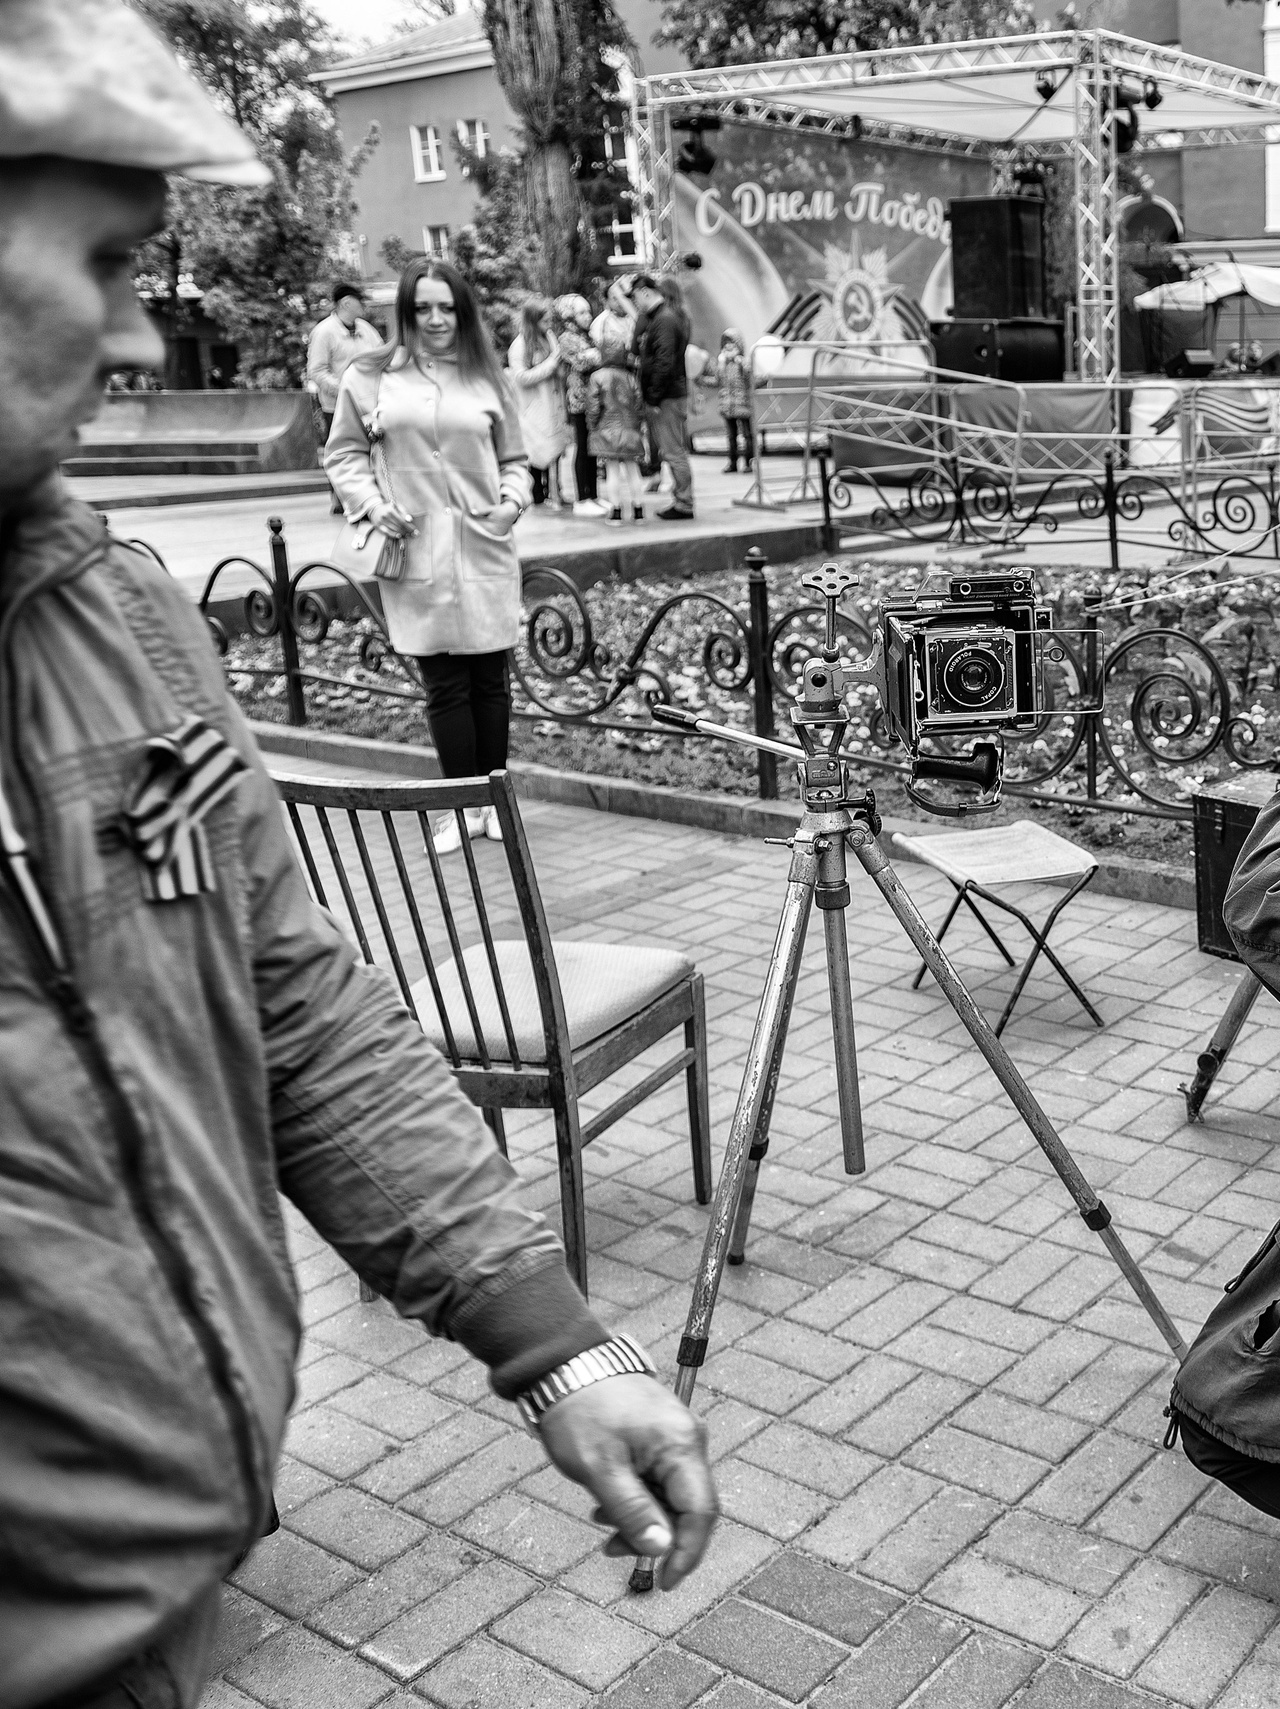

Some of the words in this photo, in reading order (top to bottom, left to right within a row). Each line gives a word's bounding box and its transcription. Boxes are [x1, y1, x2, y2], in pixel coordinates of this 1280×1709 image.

[695, 187, 726, 237] С
[731, 181, 839, 228] Днем
[949, 651, 972, 672] POLAROID
[981, 686, 997, 701] COPAL
